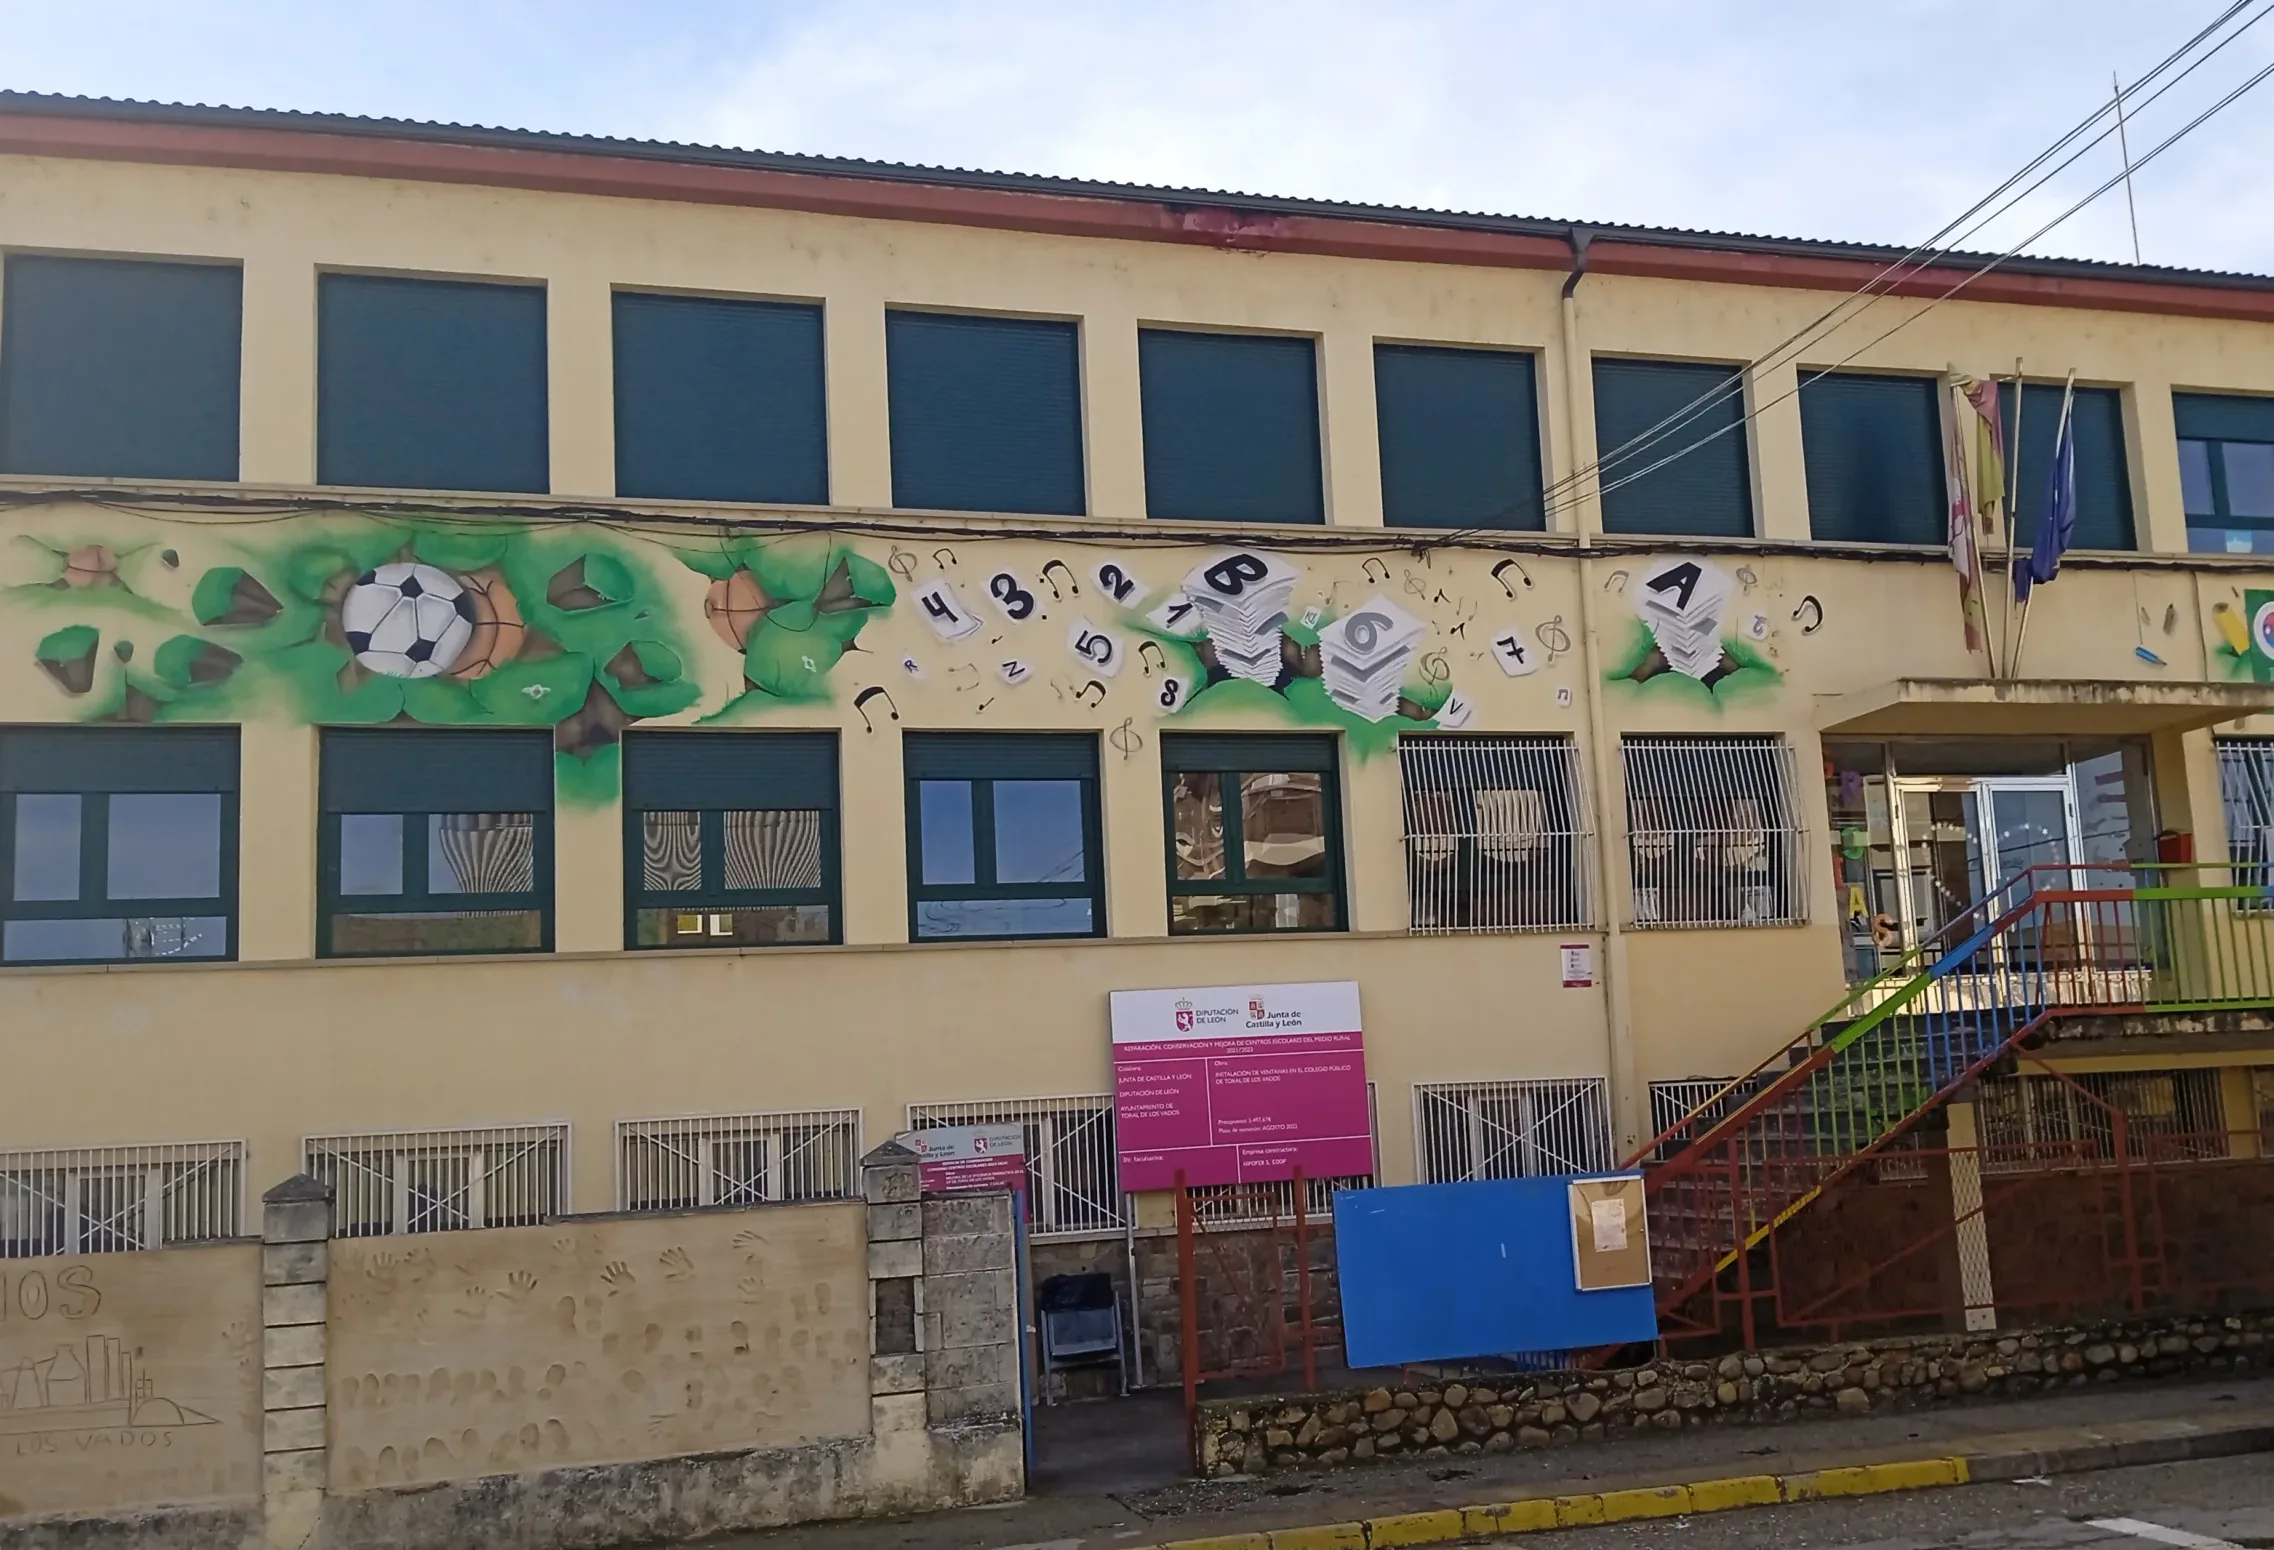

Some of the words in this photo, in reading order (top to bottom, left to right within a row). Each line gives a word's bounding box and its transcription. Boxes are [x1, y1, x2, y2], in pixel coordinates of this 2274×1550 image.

[1098, 564, 1135, 603] 2
[1203, 552, 1269, 596] B
[1646, 561, 1702, 611] A
[921, 591, 959, 624] 4
[989, 573, 1035, 620] 3
[1166, 602, 1194, 629] 1
[1074, 629, 1113, 665] 5
[1344, 611, 1394, 654] 6
[1497, 635, 1526, 665] 7
[1160, 678, 1179, 708] 8
[1196, 1008, 1239, 1017] DIPUTACIÓN
[1245, 1019, 1274, 1028] Castilla
[1282, 1018, 1302, 1027] León
[1267, 1011, 1289, 1019] Junta
[1290, 1010, 1301, 1018] de
[1214, 1040, 1236, 1048] MEJORA
[1120, 1103, 1164, 1111] AYUNTAMIENTO
[75, 1430, 174, 1452] VADOS
